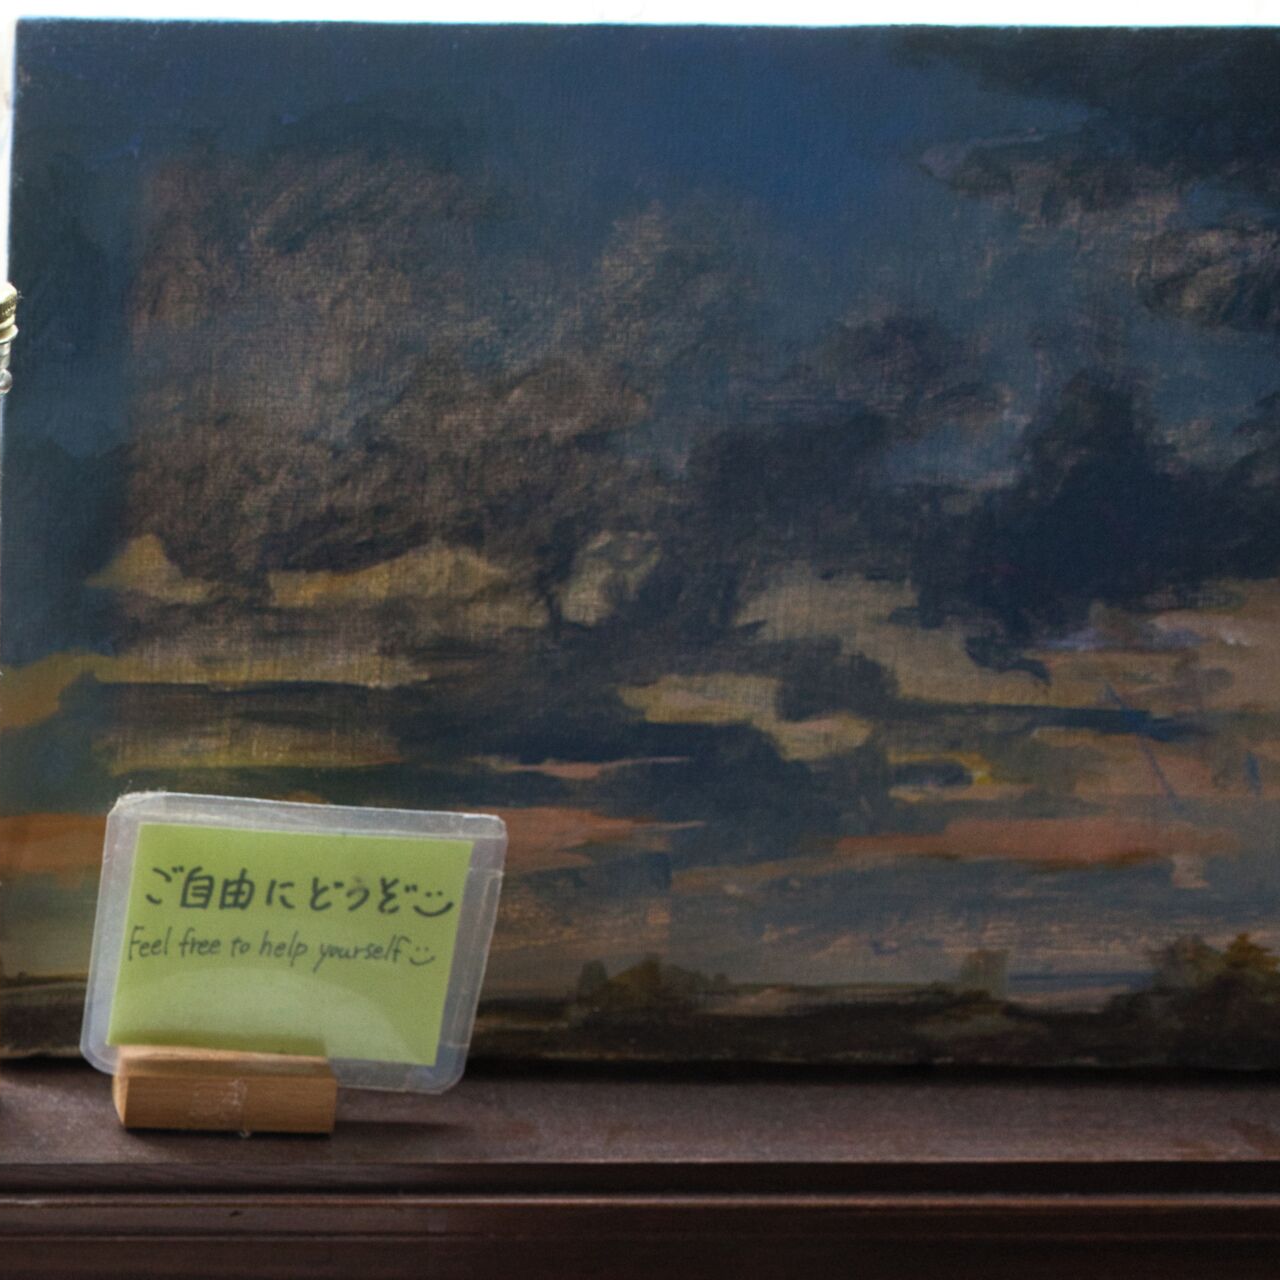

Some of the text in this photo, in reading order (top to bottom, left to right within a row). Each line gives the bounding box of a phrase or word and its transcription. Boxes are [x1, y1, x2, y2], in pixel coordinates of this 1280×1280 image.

[145, 866, 418, 914] ご自由にどうぞ
[128, 925, 413, 974] Feel free to help yourself
